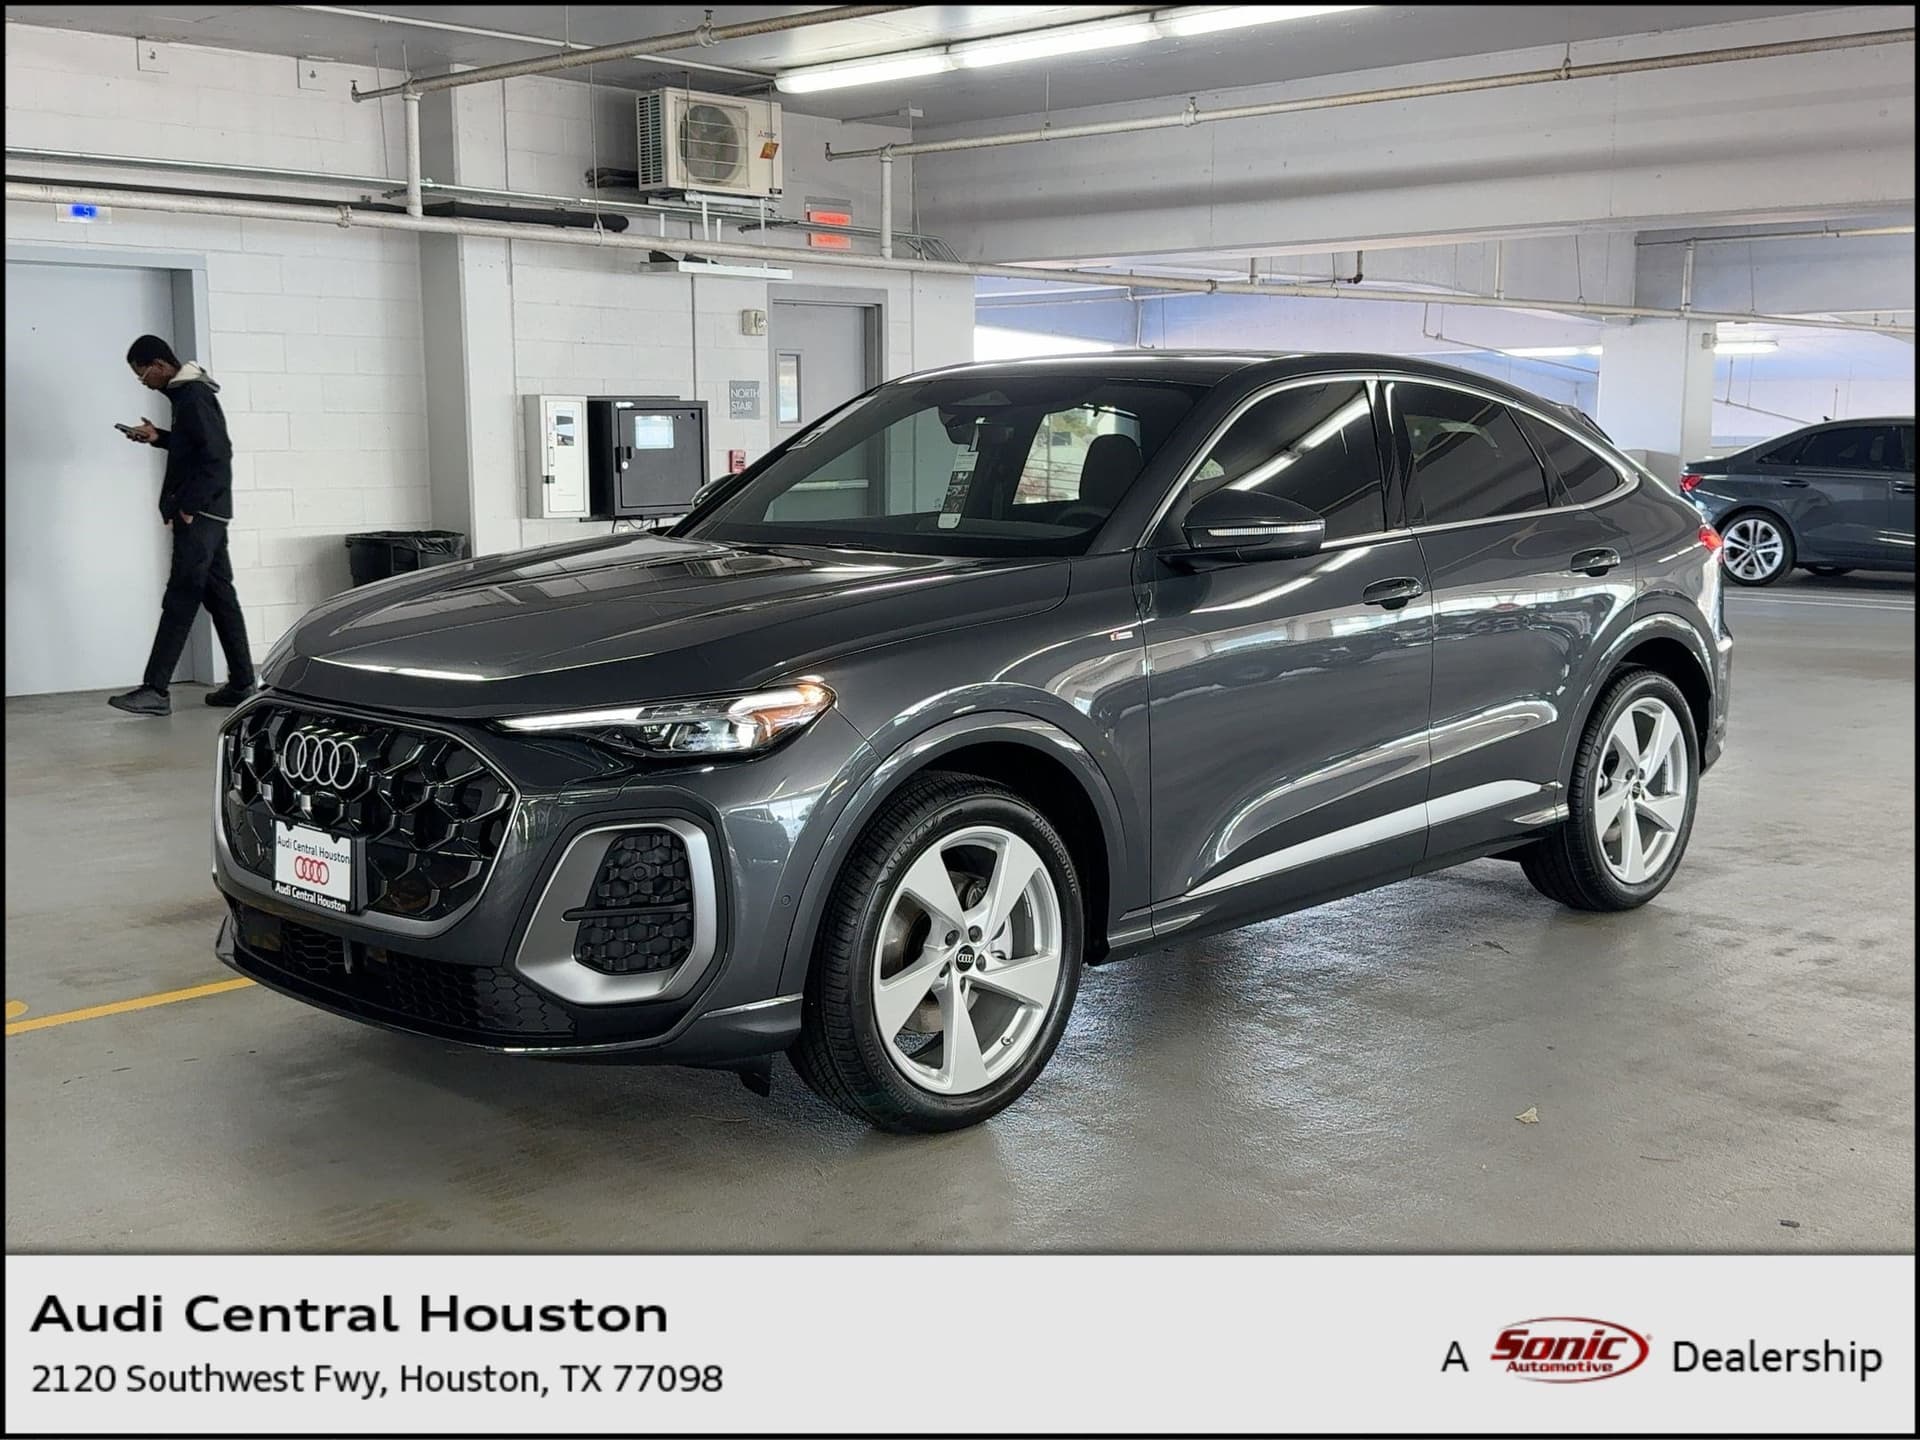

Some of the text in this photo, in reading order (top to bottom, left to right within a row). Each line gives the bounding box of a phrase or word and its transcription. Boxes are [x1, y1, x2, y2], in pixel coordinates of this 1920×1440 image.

[731, 401, 753, 411] STAIR
[277, 835, 351, 864] Audi Central Houston
[275, 882, 346, 912] Audi Central Houston
